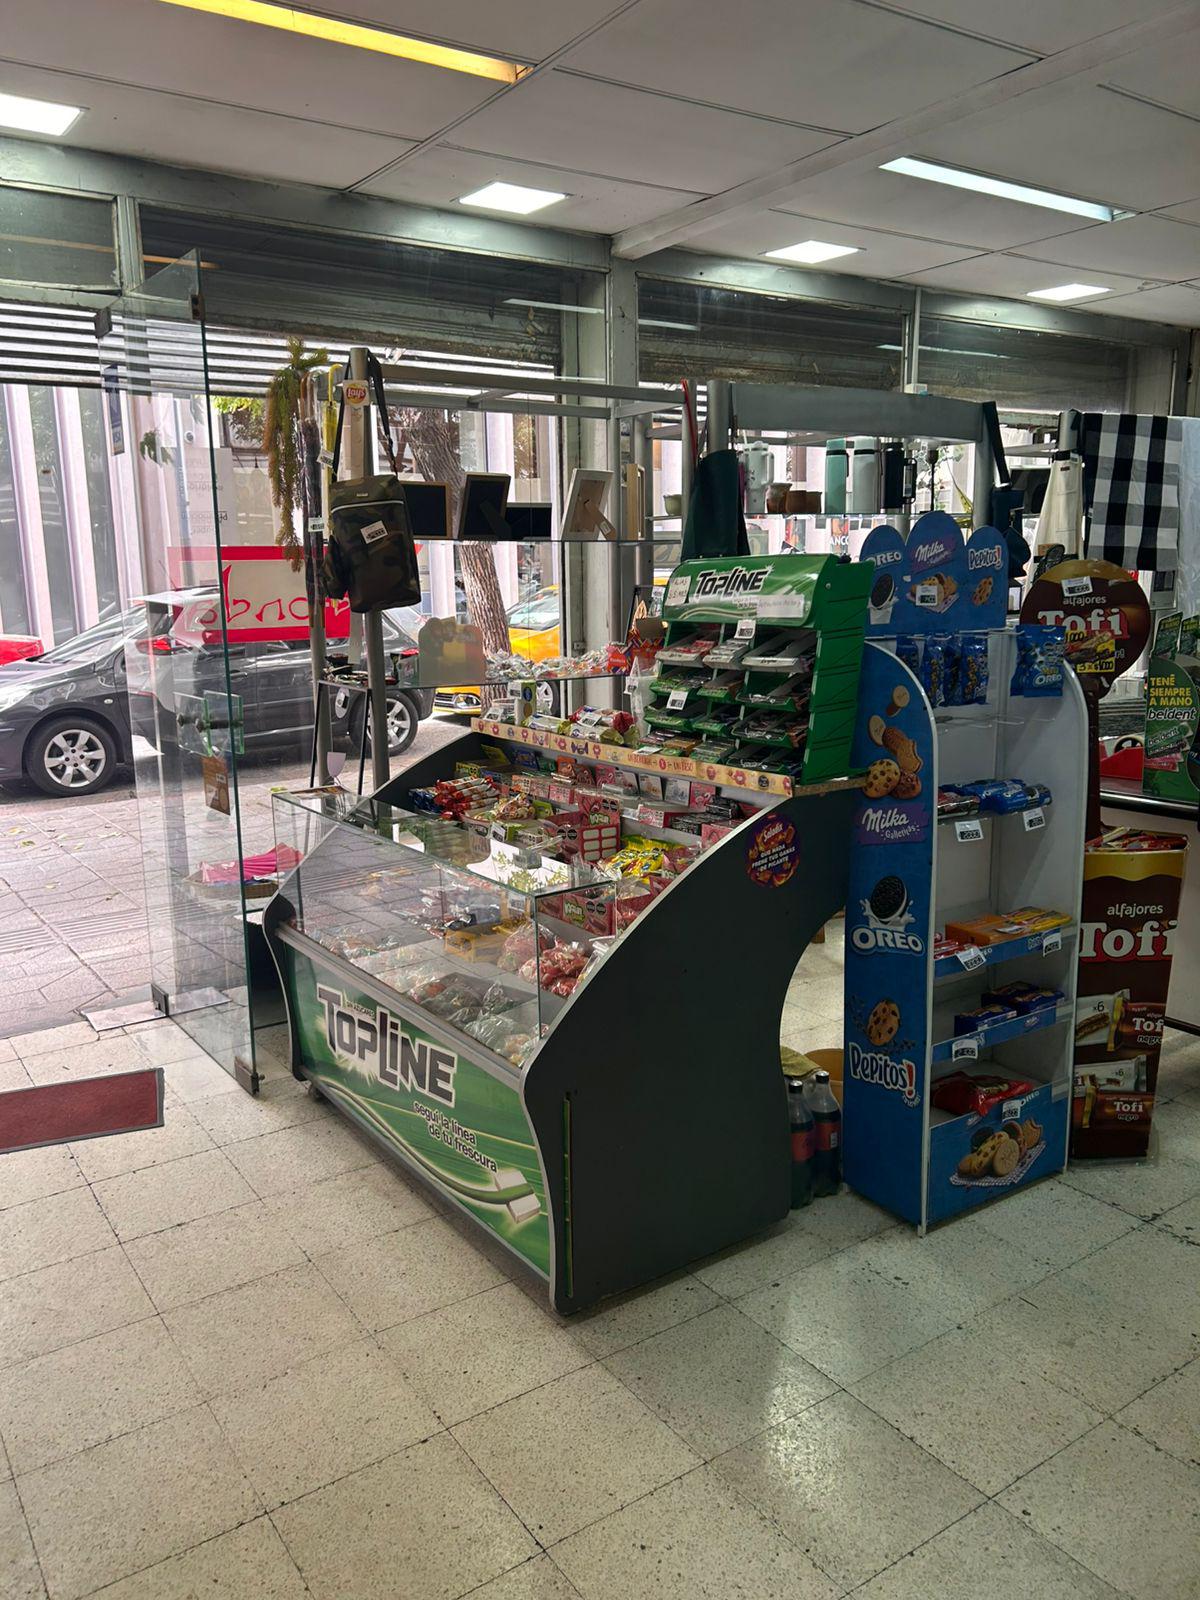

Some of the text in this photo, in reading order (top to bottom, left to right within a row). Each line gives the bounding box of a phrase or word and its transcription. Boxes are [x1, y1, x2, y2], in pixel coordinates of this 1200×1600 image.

[915, 541, 944, 562] Milka
[968, 545, 1003, 570] Pepitos!
[1038, 608, 1122, 635] Tofi
[1149, 687, 1191, 697] SIEMPRE
[1149, 697, 1192, 706] A MANO
[1148, 708, 1196, 720] beldent
[862, 808, 909, 832] Milka
[1107, 904, 1163, 917] alfajores
[852, 926, 923, 953] OREO
[1079, 920, 1177, 957] Tofi
[1093, 1001, 1104, 1012] x6
[849, 1043, 916, 1098] Pepitos!
[1114, 1101, 1143, 1112] Tofi
[439, 1112, 450, 1129] la
[429, 1123, 497, 1172] de tu frescura
